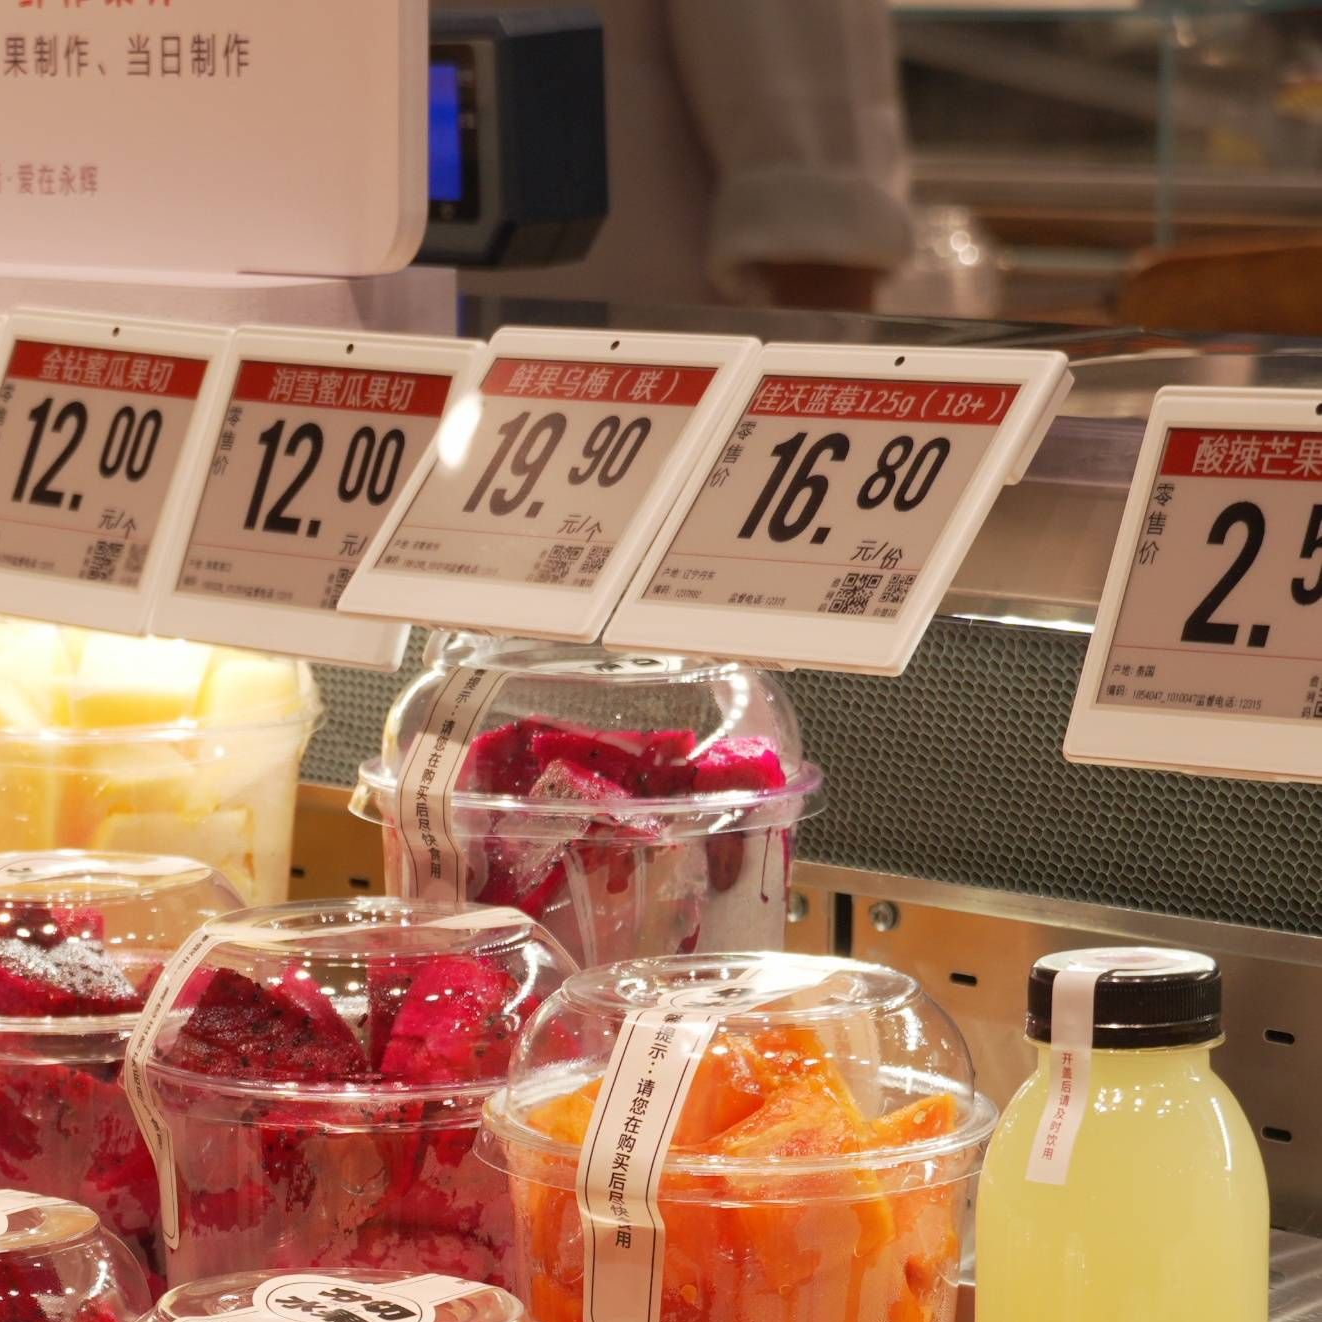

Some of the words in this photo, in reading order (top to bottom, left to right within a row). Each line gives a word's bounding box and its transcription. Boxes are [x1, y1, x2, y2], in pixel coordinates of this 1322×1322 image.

[39, 348, 175, 393] 金钻蜜瓜果切
[1192, 434, 1322, 476] 酸辣芒果
[1138, 482, 1175, 566] 零售价
[1041, 1052, 1073, 1161] 开盖后请及时饮用
